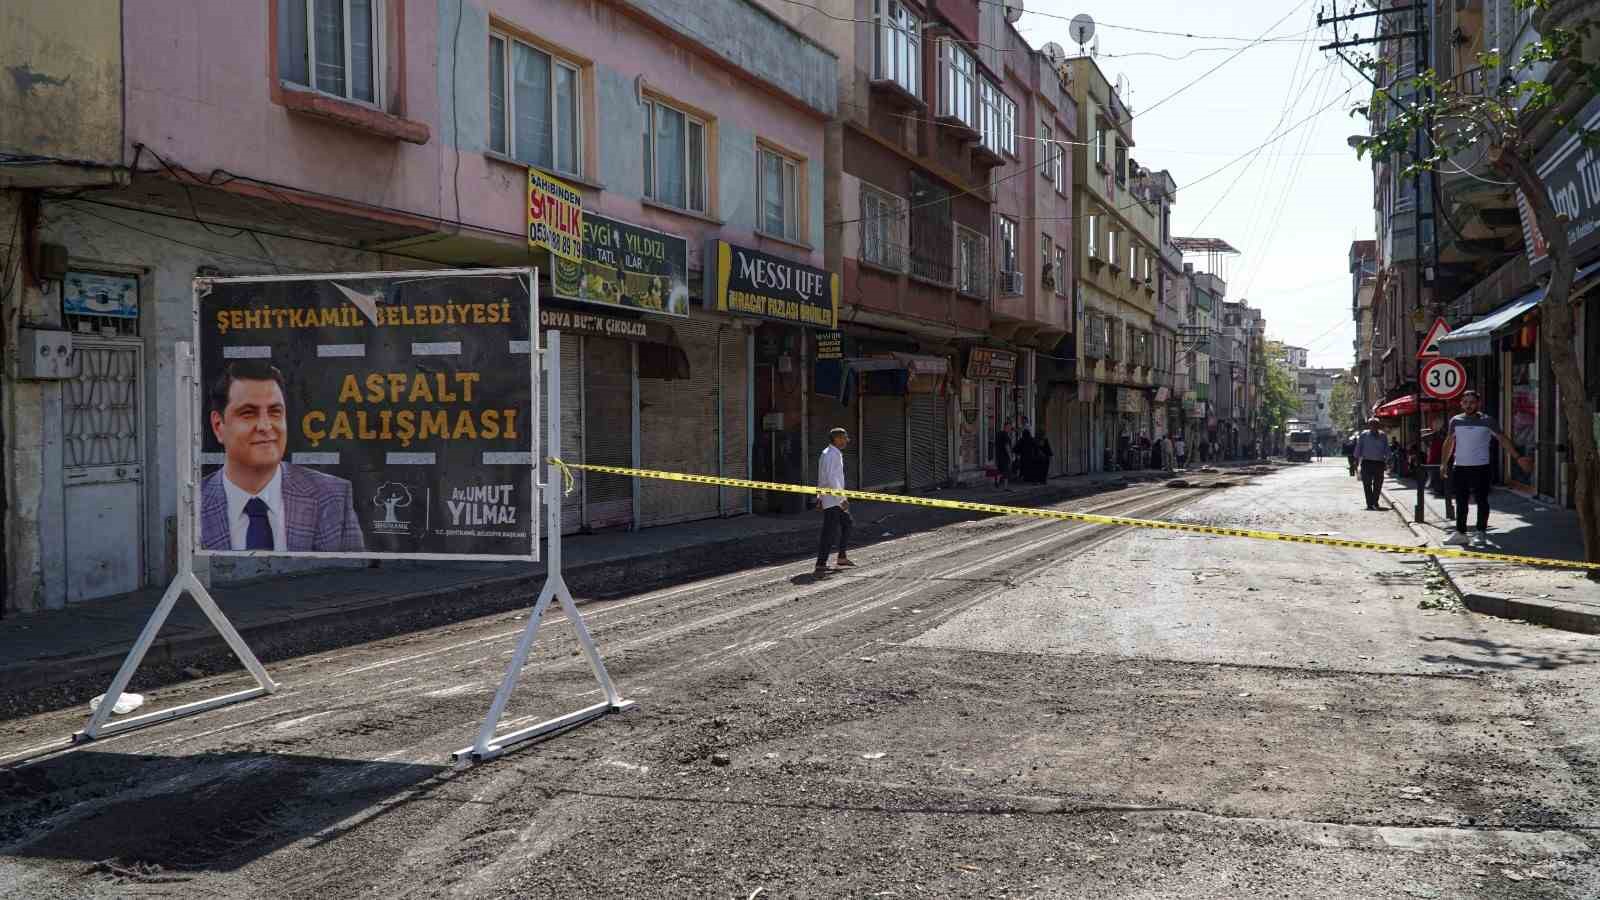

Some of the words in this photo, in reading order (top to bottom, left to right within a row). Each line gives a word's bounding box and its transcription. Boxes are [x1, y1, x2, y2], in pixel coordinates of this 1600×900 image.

[582, 222, 611, 248] EVGİ
[738, 251, 791, 290] MESSI
[795, 268, 823, 300] LIFE
[217, 304, 364, 334] ŞEHİTKAMİL
[376, 298, 511, 326] BELEDİYESİ
[338, 372, 481, 403] ASFALT
[1430, 369, 1457, 388] 30
[302, 409, 518, 447] ÇALIŞMASI
[447, 501, 516, 526] YILMAZ
